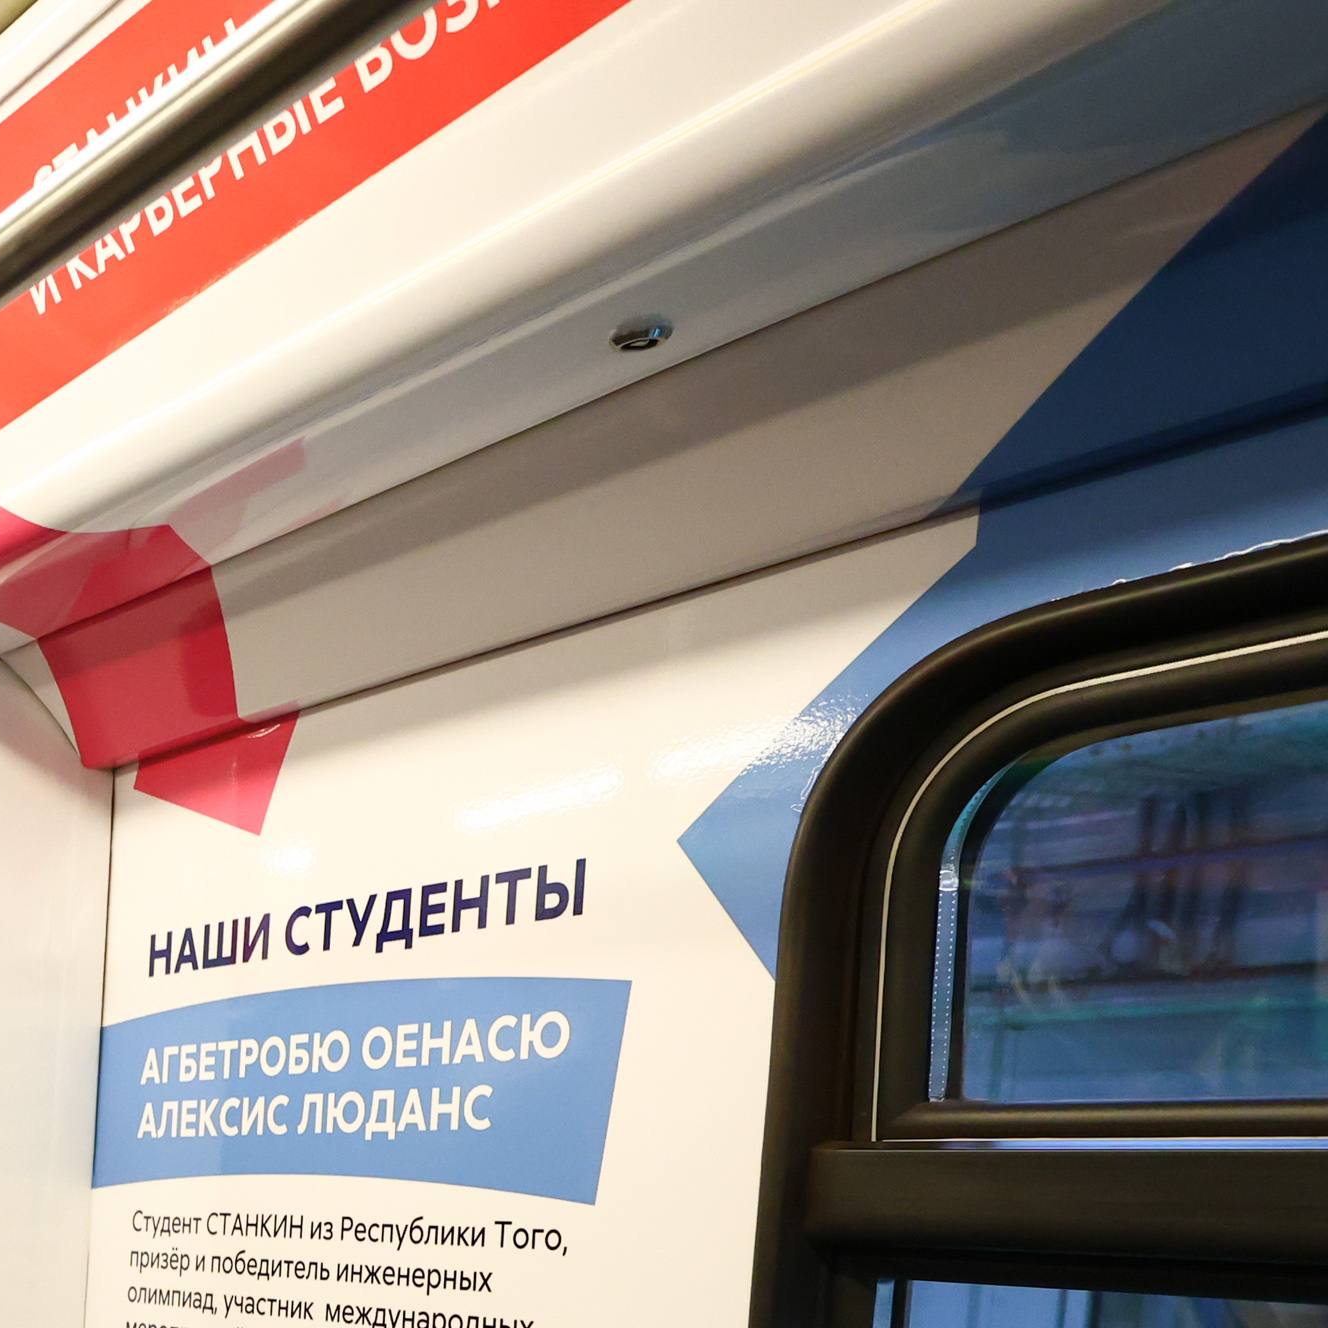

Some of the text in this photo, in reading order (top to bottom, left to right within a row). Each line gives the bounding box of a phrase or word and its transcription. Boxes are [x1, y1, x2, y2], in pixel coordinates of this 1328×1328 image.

[354, 0, 500, 93] ВОЗ
[148, 858, 586, 978] НАШИ СТУДЕНТЫ
[140, 1010, 571, 1085] АГБЕТРОБЮ ОЕНАСЮ
[137, 1084, 493, 1140] АЛЕКСИС ЛЮДАНС
[132, 1209, 569, 1257] Студент СТАНКИН из Республики Того,
[130, 1246, 493, 1297] призёр и победитель инженерных
[127, 1284, 218, 1316] олимпиад,
[223, 1293, 314, 1321] участник
